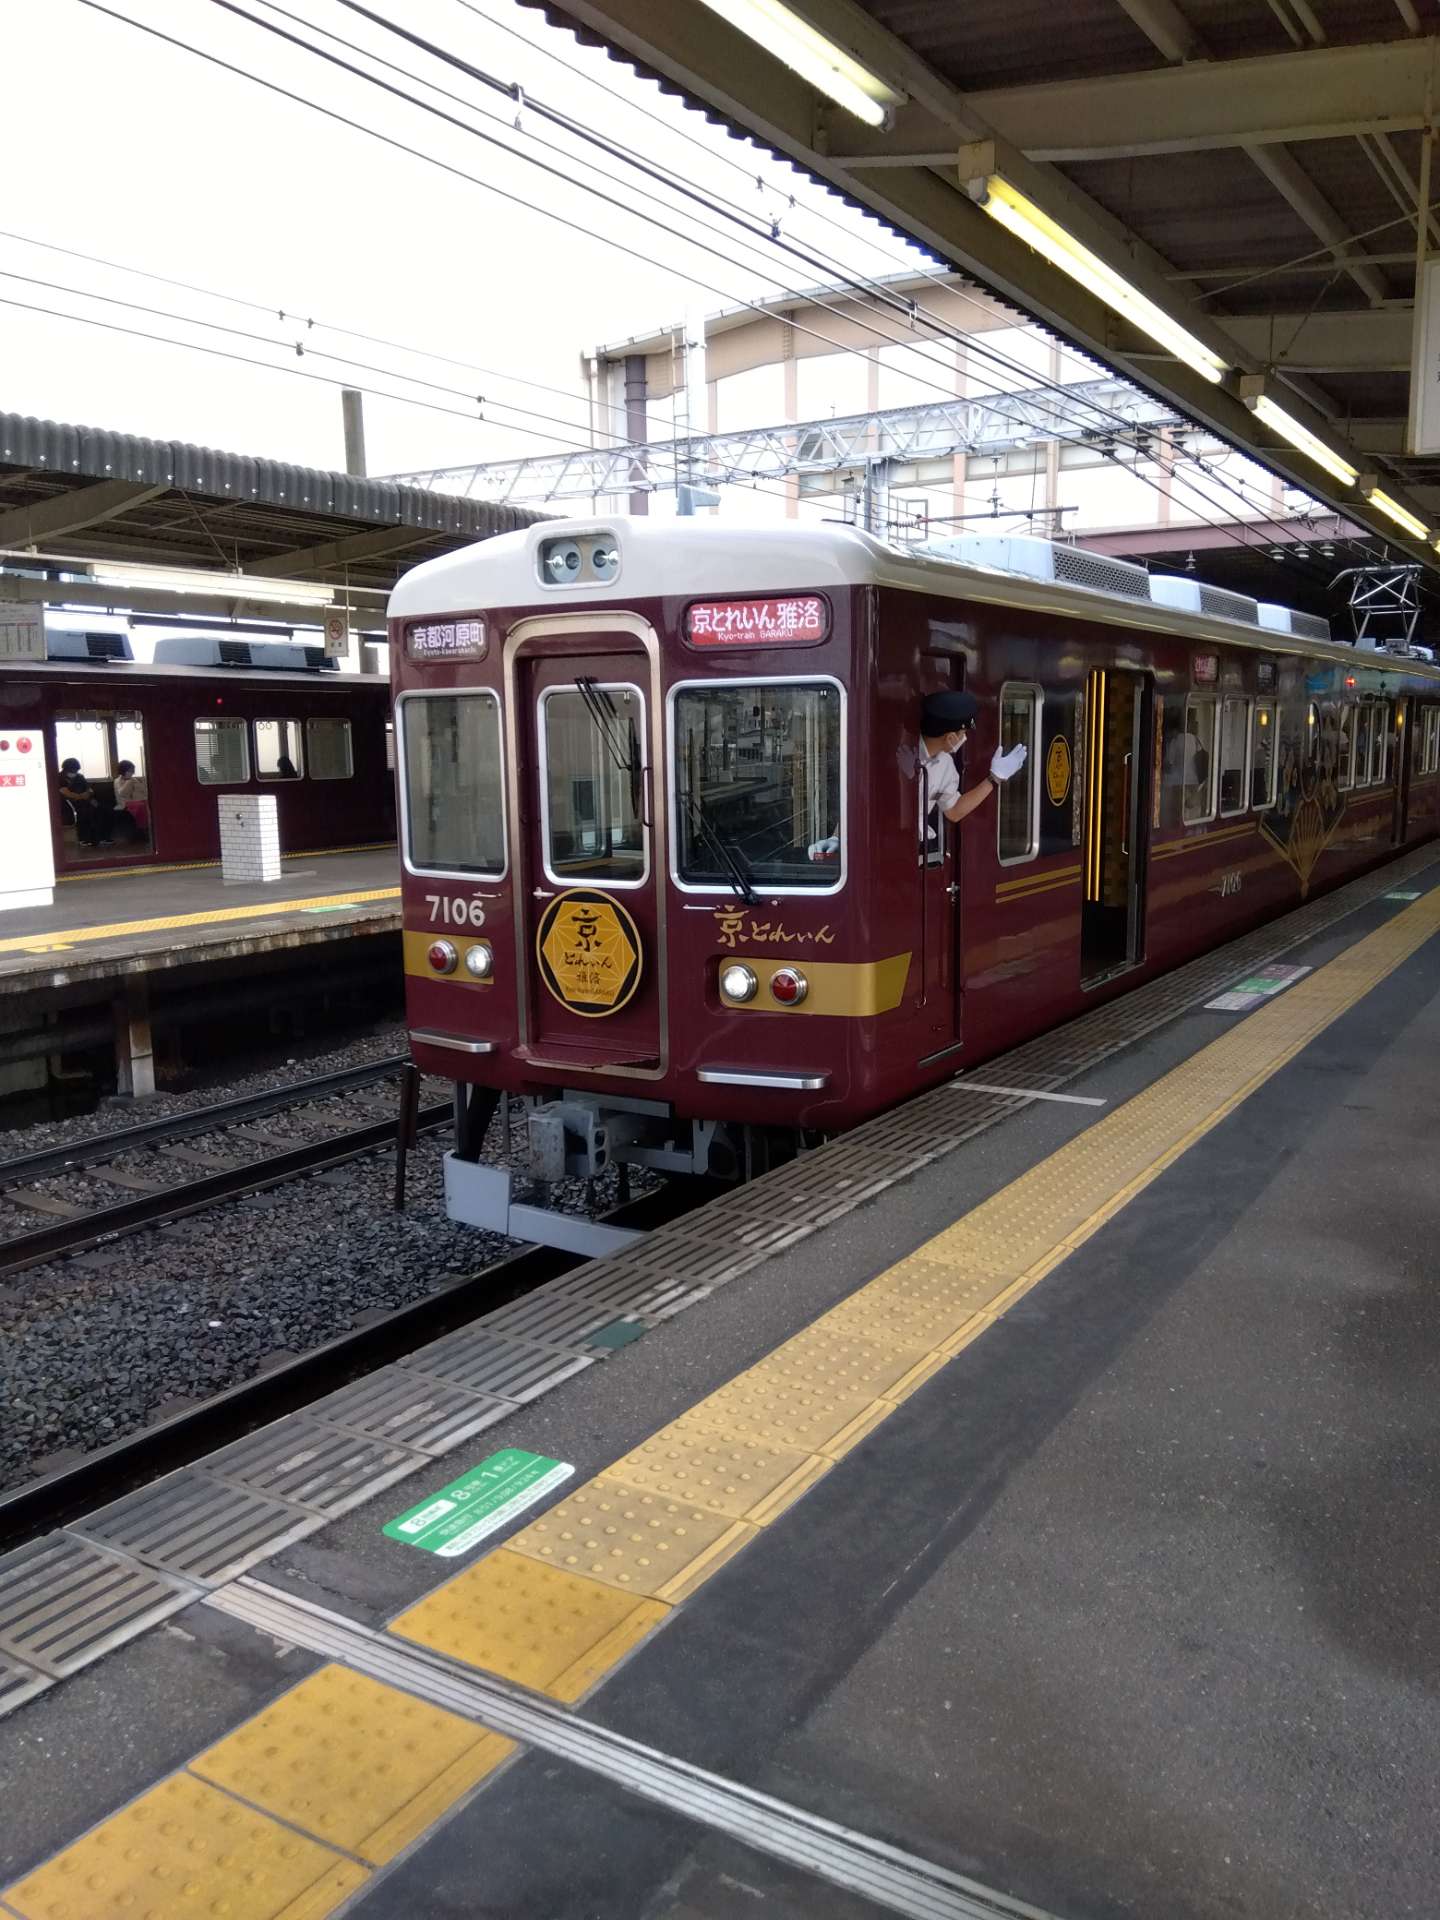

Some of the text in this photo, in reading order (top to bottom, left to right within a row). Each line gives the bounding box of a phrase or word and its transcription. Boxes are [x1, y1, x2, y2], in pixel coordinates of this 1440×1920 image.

[413, 623, 485, 649] 京都河原町
[718, 629, 793, 641] Kyo-train GARAKU
[425, 895, 485, 927] 7106
[572, 909, 602, 952] 京
[713, 905, 836, 948] 京とれいん
[563, 951, 613, 969] とれいん
